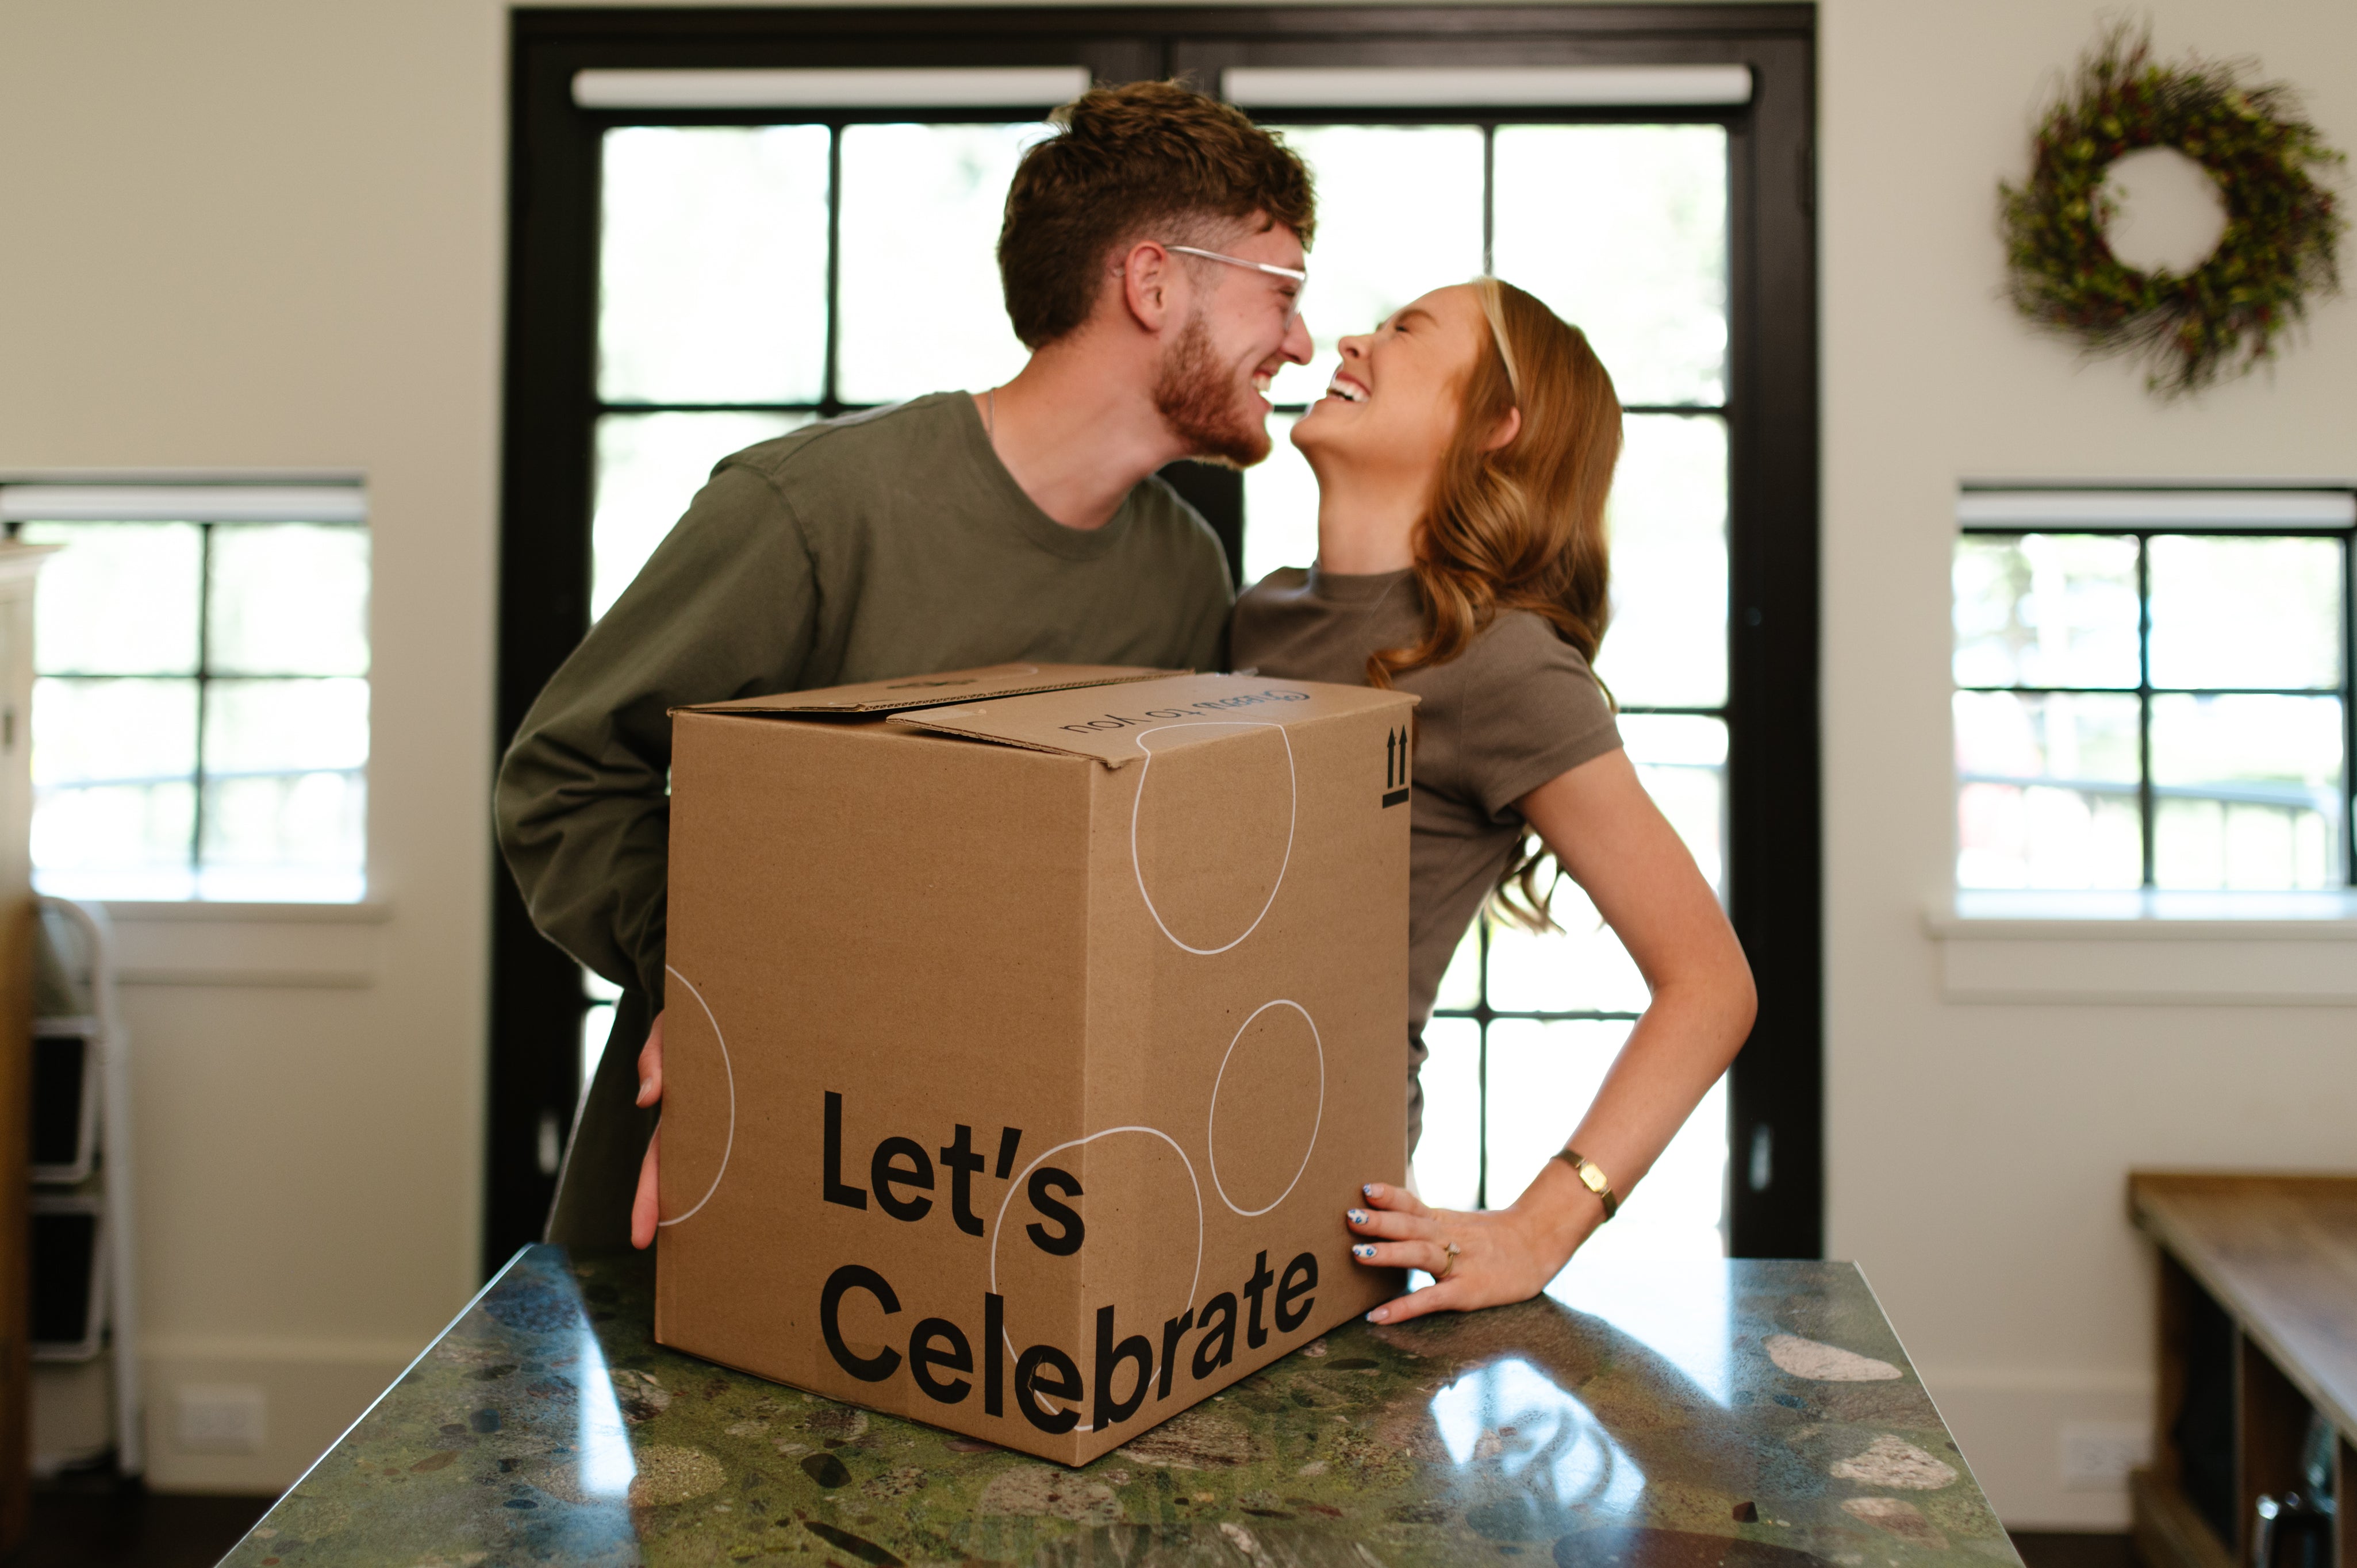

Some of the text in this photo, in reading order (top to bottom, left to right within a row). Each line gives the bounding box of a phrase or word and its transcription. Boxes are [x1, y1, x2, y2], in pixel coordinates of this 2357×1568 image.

[1059, 690, 1311, 733] Cheers to you
[823, 1090, 1085, 1256] Let's
[820, 1248, 1319, 1435] Celebrate
